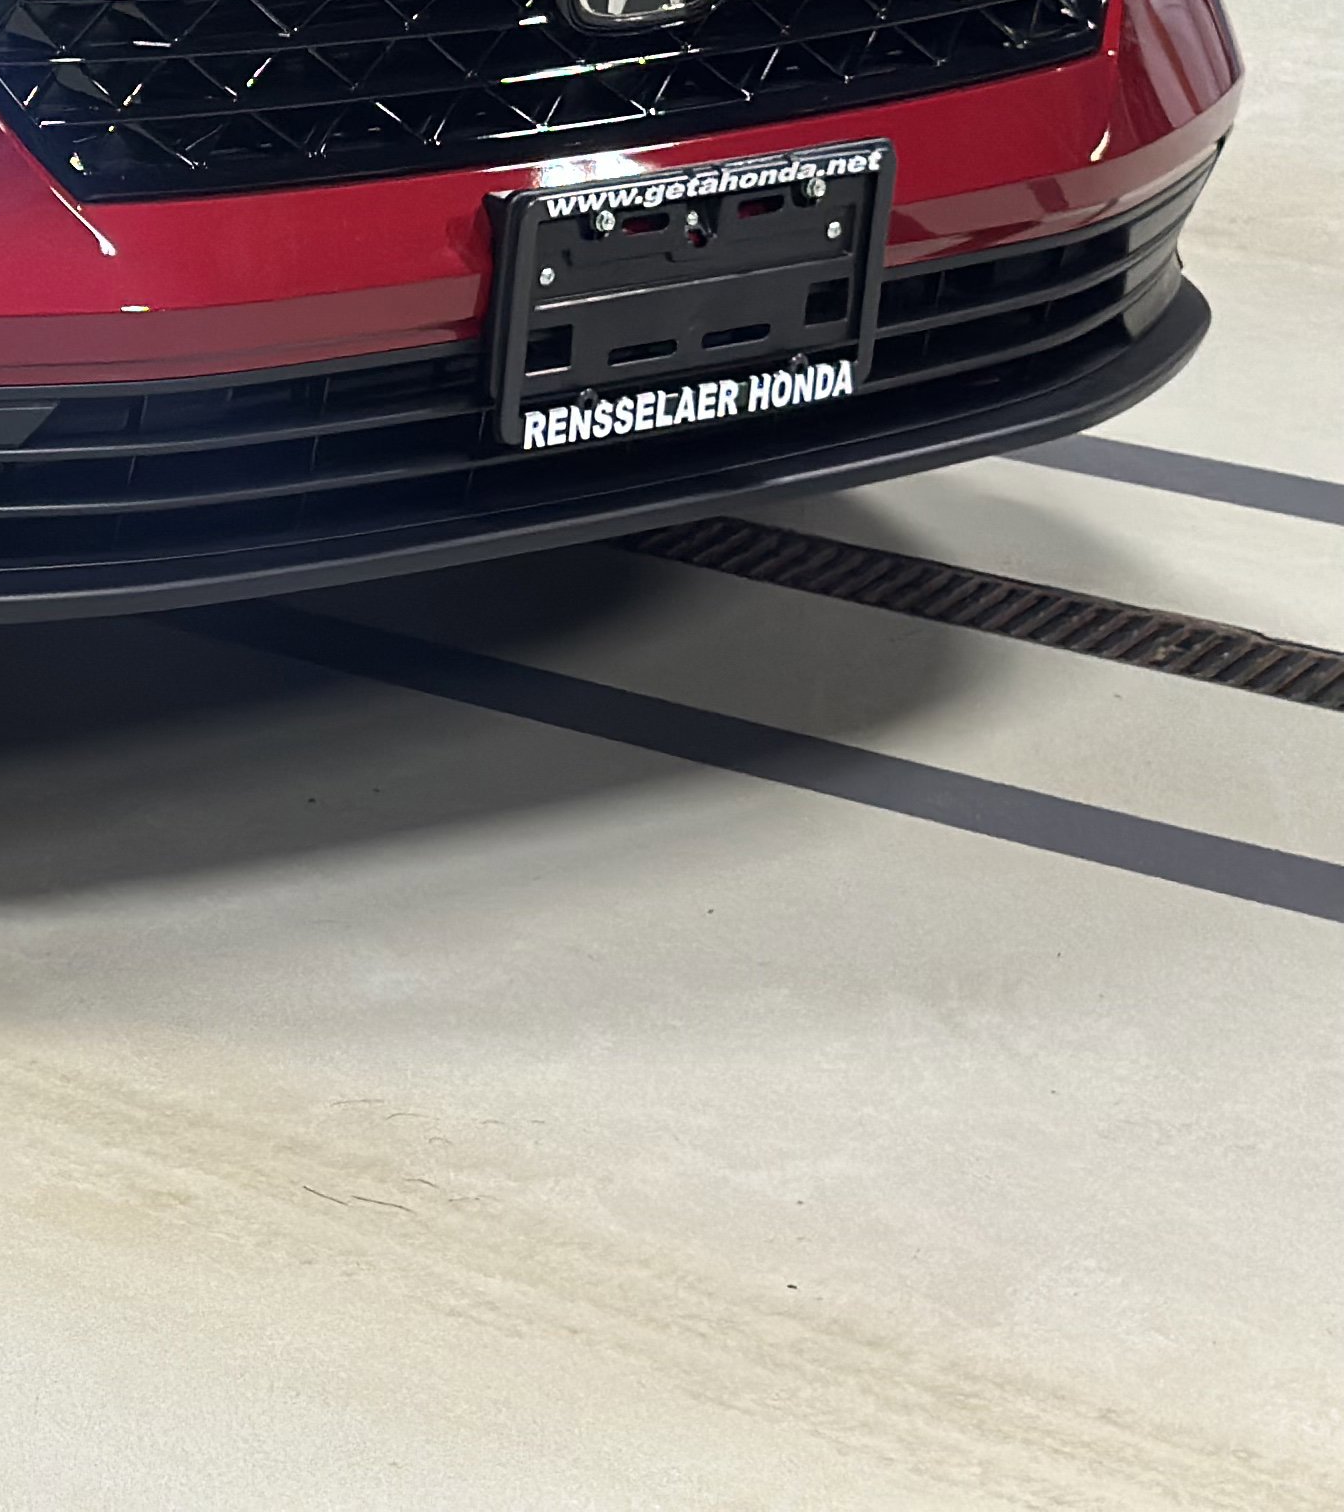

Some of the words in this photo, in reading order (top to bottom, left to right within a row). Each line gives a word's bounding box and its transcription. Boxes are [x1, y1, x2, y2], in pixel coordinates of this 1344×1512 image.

[546, 150, 883, 217] www.getahonda.net
[523, 380, 738, 449] RENSSELAER
[747, 360, 854, 412] HONDA
